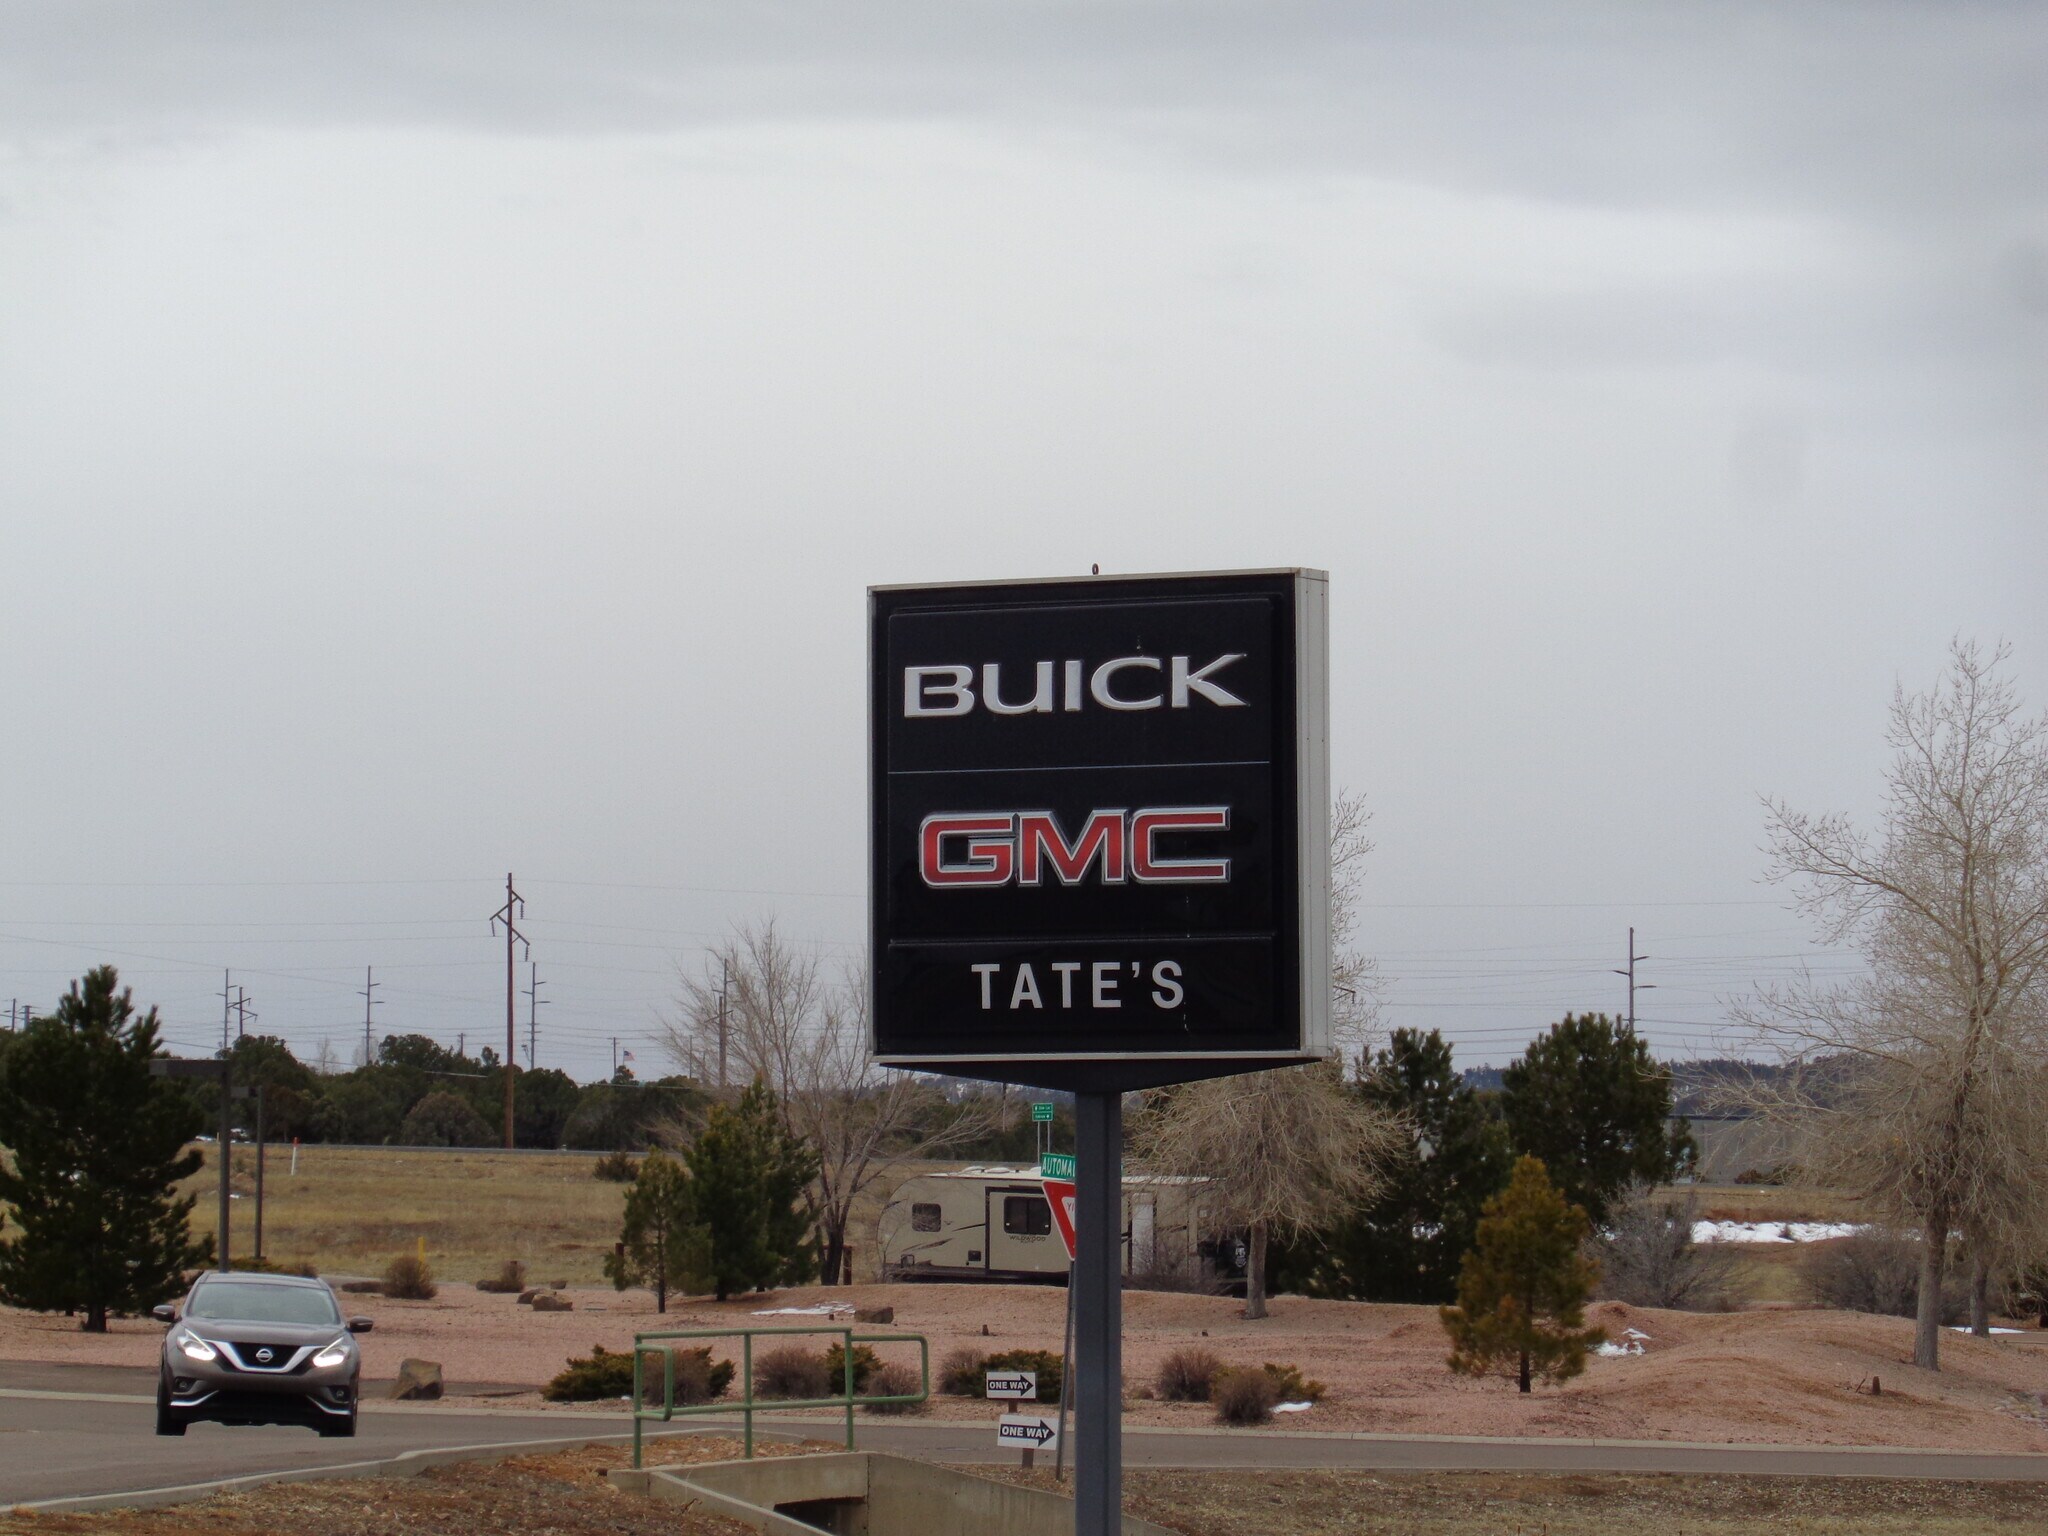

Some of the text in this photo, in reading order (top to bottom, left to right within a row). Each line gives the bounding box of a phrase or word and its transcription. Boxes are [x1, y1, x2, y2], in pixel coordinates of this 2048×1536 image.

[904, 654, 1249, 717] BUICK
[919, 806, 1231, 887] GMC
[971, 961, 1184, 1009] TATE'S
[989, 1381, 1029, 1390] ONE WAY
[1001, 1426, 1050, 1439] ONE WAY
